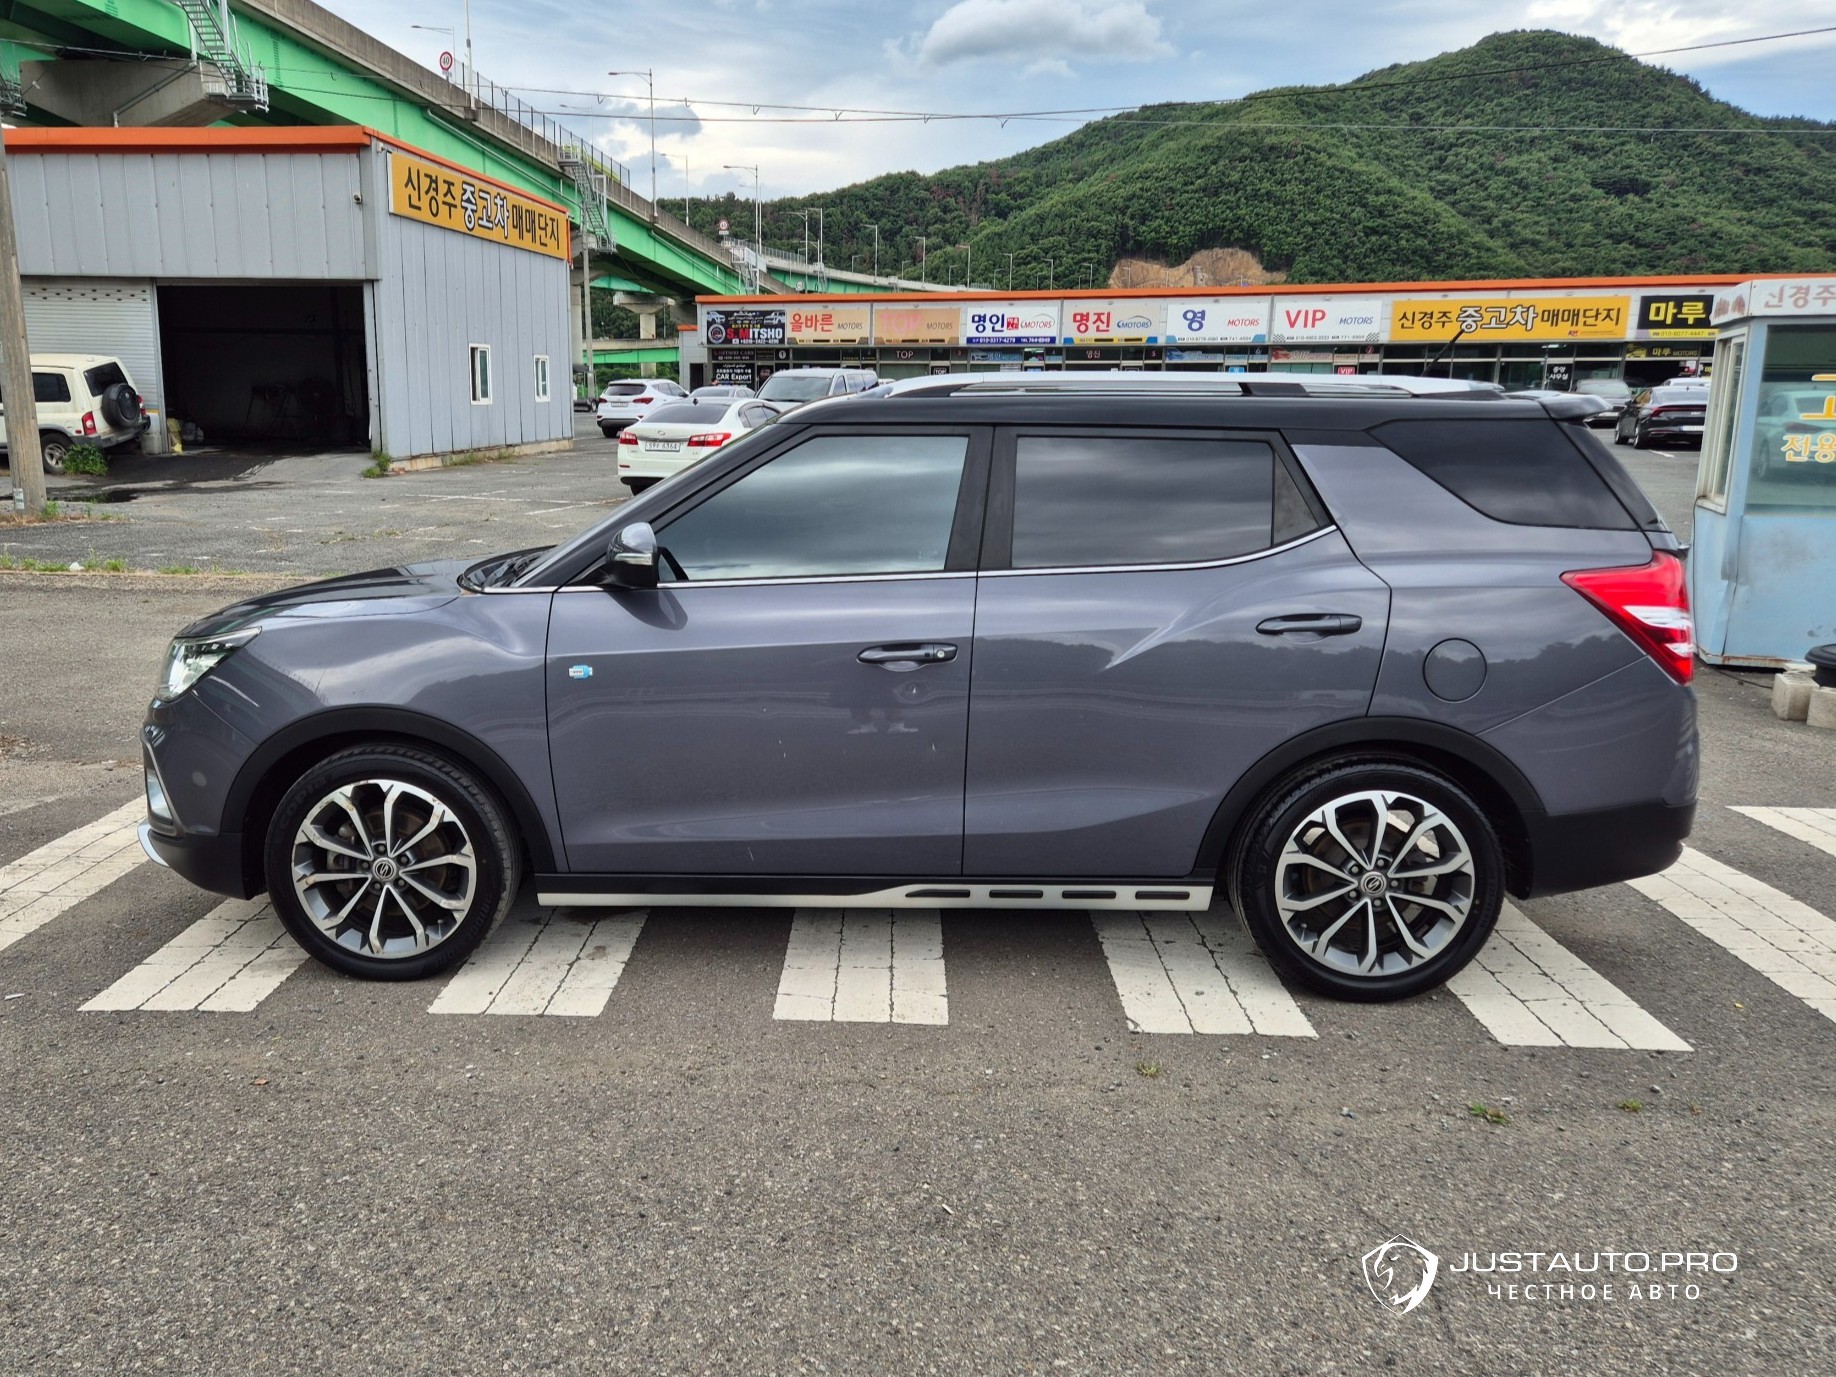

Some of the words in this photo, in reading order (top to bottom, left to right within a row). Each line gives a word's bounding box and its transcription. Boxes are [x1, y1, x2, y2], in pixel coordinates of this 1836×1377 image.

[404, 166, 458, 219] 신경주
[461, 180, 510, 239] 중고차
[511, 204, 560, 250] 매매단지
[790, 312, 834, 333] 올바른
[971, 313, 1005, 333] 명인
[1072, 311, 1111, 333] 명진
[1183, 309, 1206, 332] 영
[1227, 319, 1260, 327] MOTORS
[1285, 309, 1327, 329] VIP
[1339, 317, 1373, 325] MOTORS
[1398, 310, 1453, 330] 신경주
[1456, 304, 1538, 334] 중고차
[1541, 307, 1621, 328] 매매단지
[1649, 301, 1706, 325] 마루
[837, 322, 863, 330] MOTORS
[926, 322, 953, 330] MOTORS
[896, 350, 914, 359] TOP
[731, 373, 752, 381] Export
